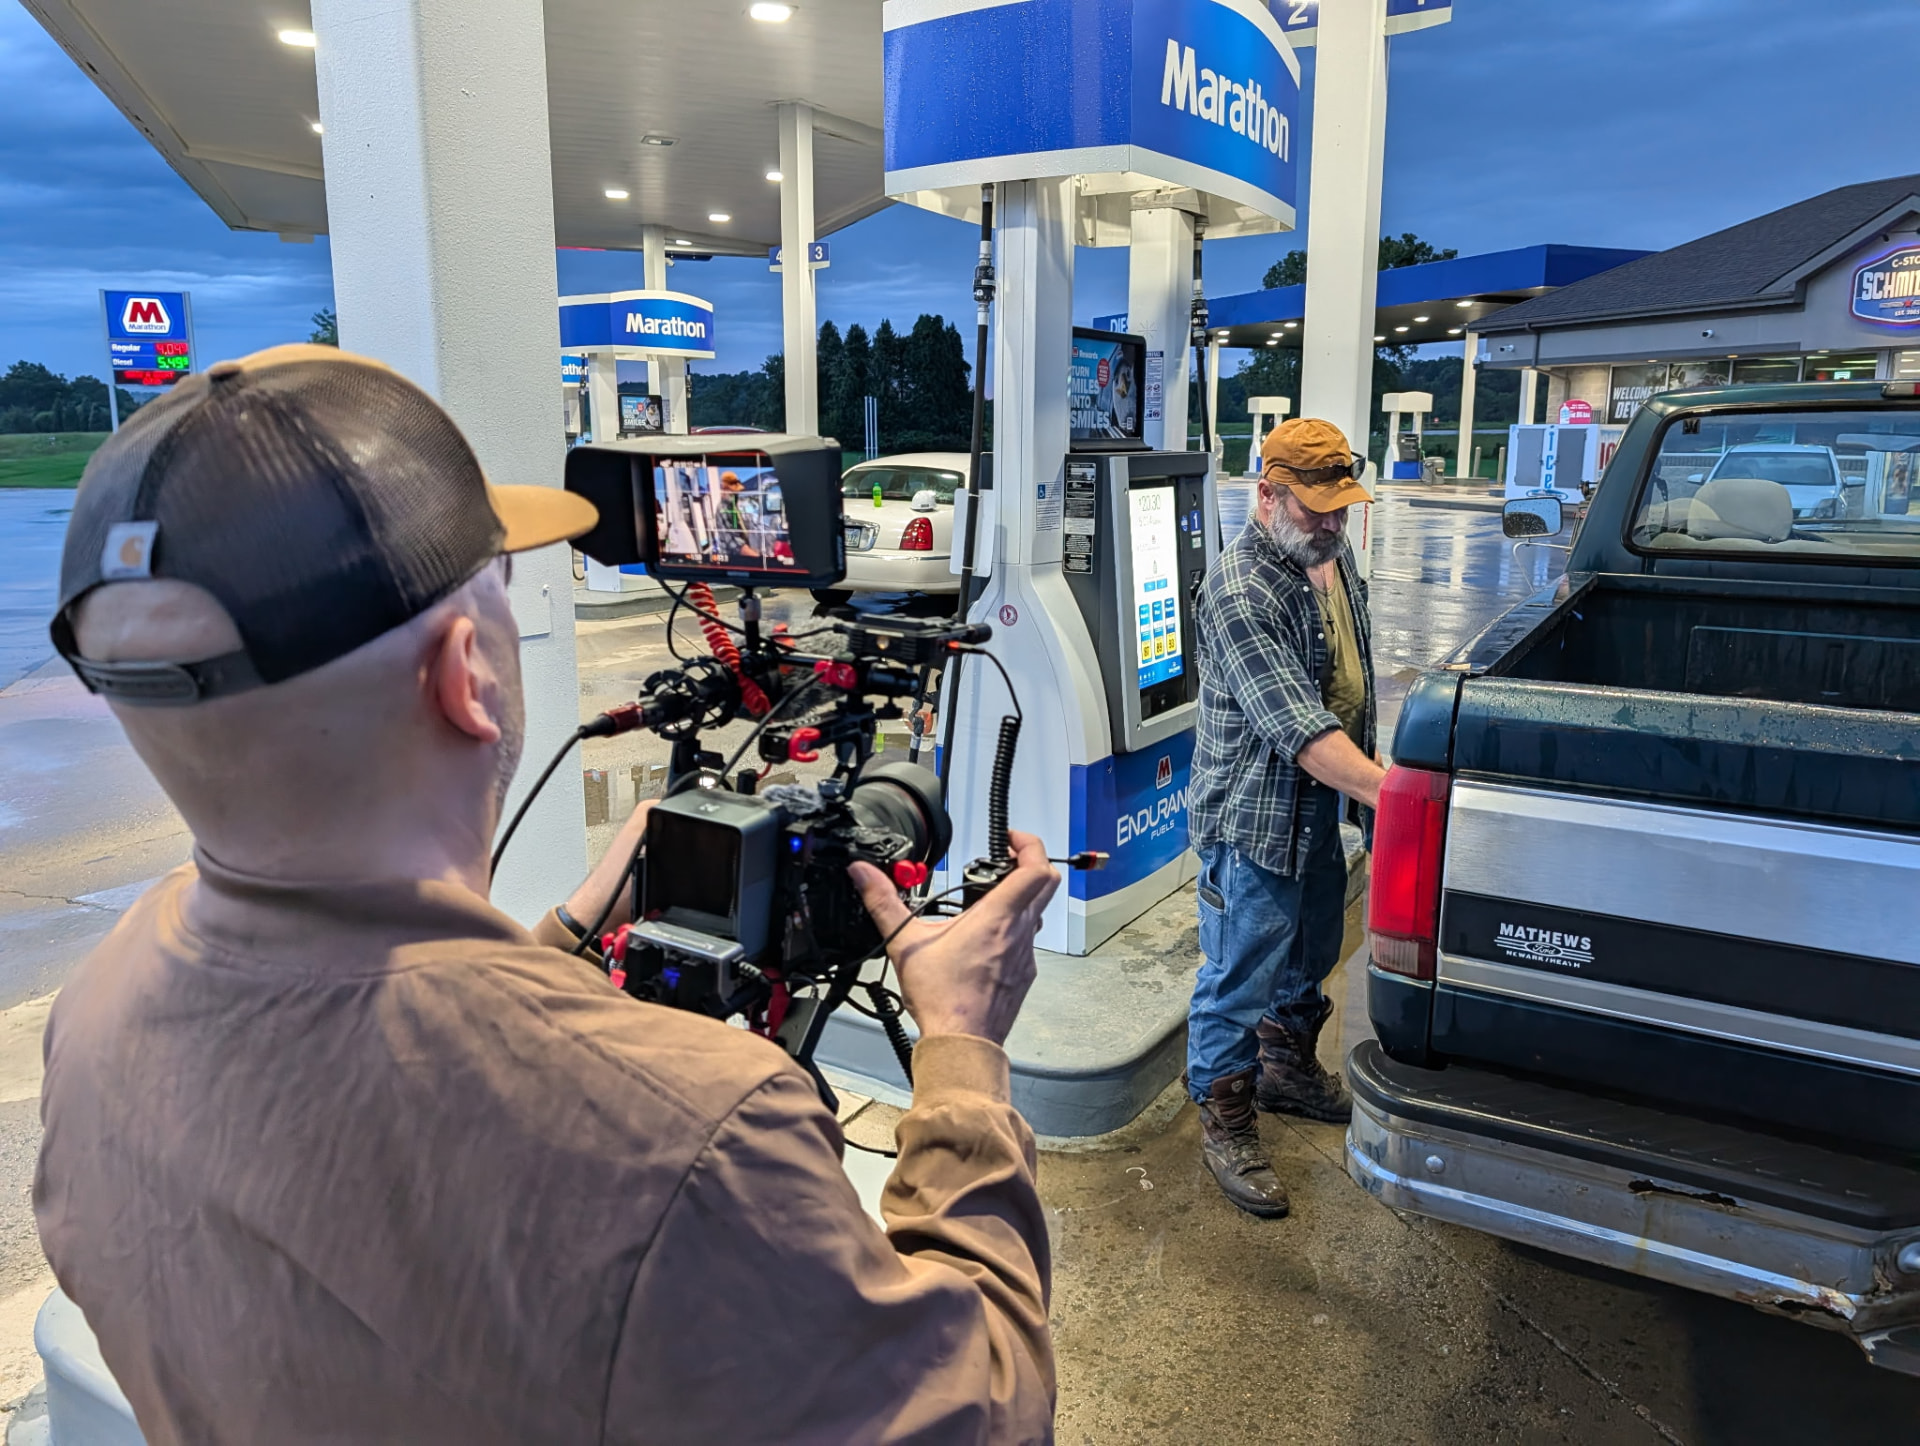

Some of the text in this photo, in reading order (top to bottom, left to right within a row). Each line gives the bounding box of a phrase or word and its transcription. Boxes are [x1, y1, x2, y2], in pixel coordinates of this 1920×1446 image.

[1287, 0, 1308, 25] 2
[1161, 38, 1289, 164] Marathon
[775, 249, 783, 263] 4
[815, 246, 823, 260] 3
[128, 302, 164, 323] M
[128, 323, 167, 331] Marathon
[625, 312, 706, 339] Marathon
[111, 343, 141, 353] Regular
[112, 358, 133, 366] Diesel
[1072, 366, 1090, 378] TURN
[1072, 378, 1100, 395] MILES
[1613, 386, 1652, 400] WELCOME
[1072, 395, 1091, 408] INTO
[1071, 410, 1110, 428] SMILES
[1193, 512, 1199, 529] 1
[1117, 786, 1188, 848] ENDURAN
[1150, 819, 1175, 841] FUELS
[1500, 922, 1592, 950] MATHEWS
[1532, 944, 1556, 955] Ford
